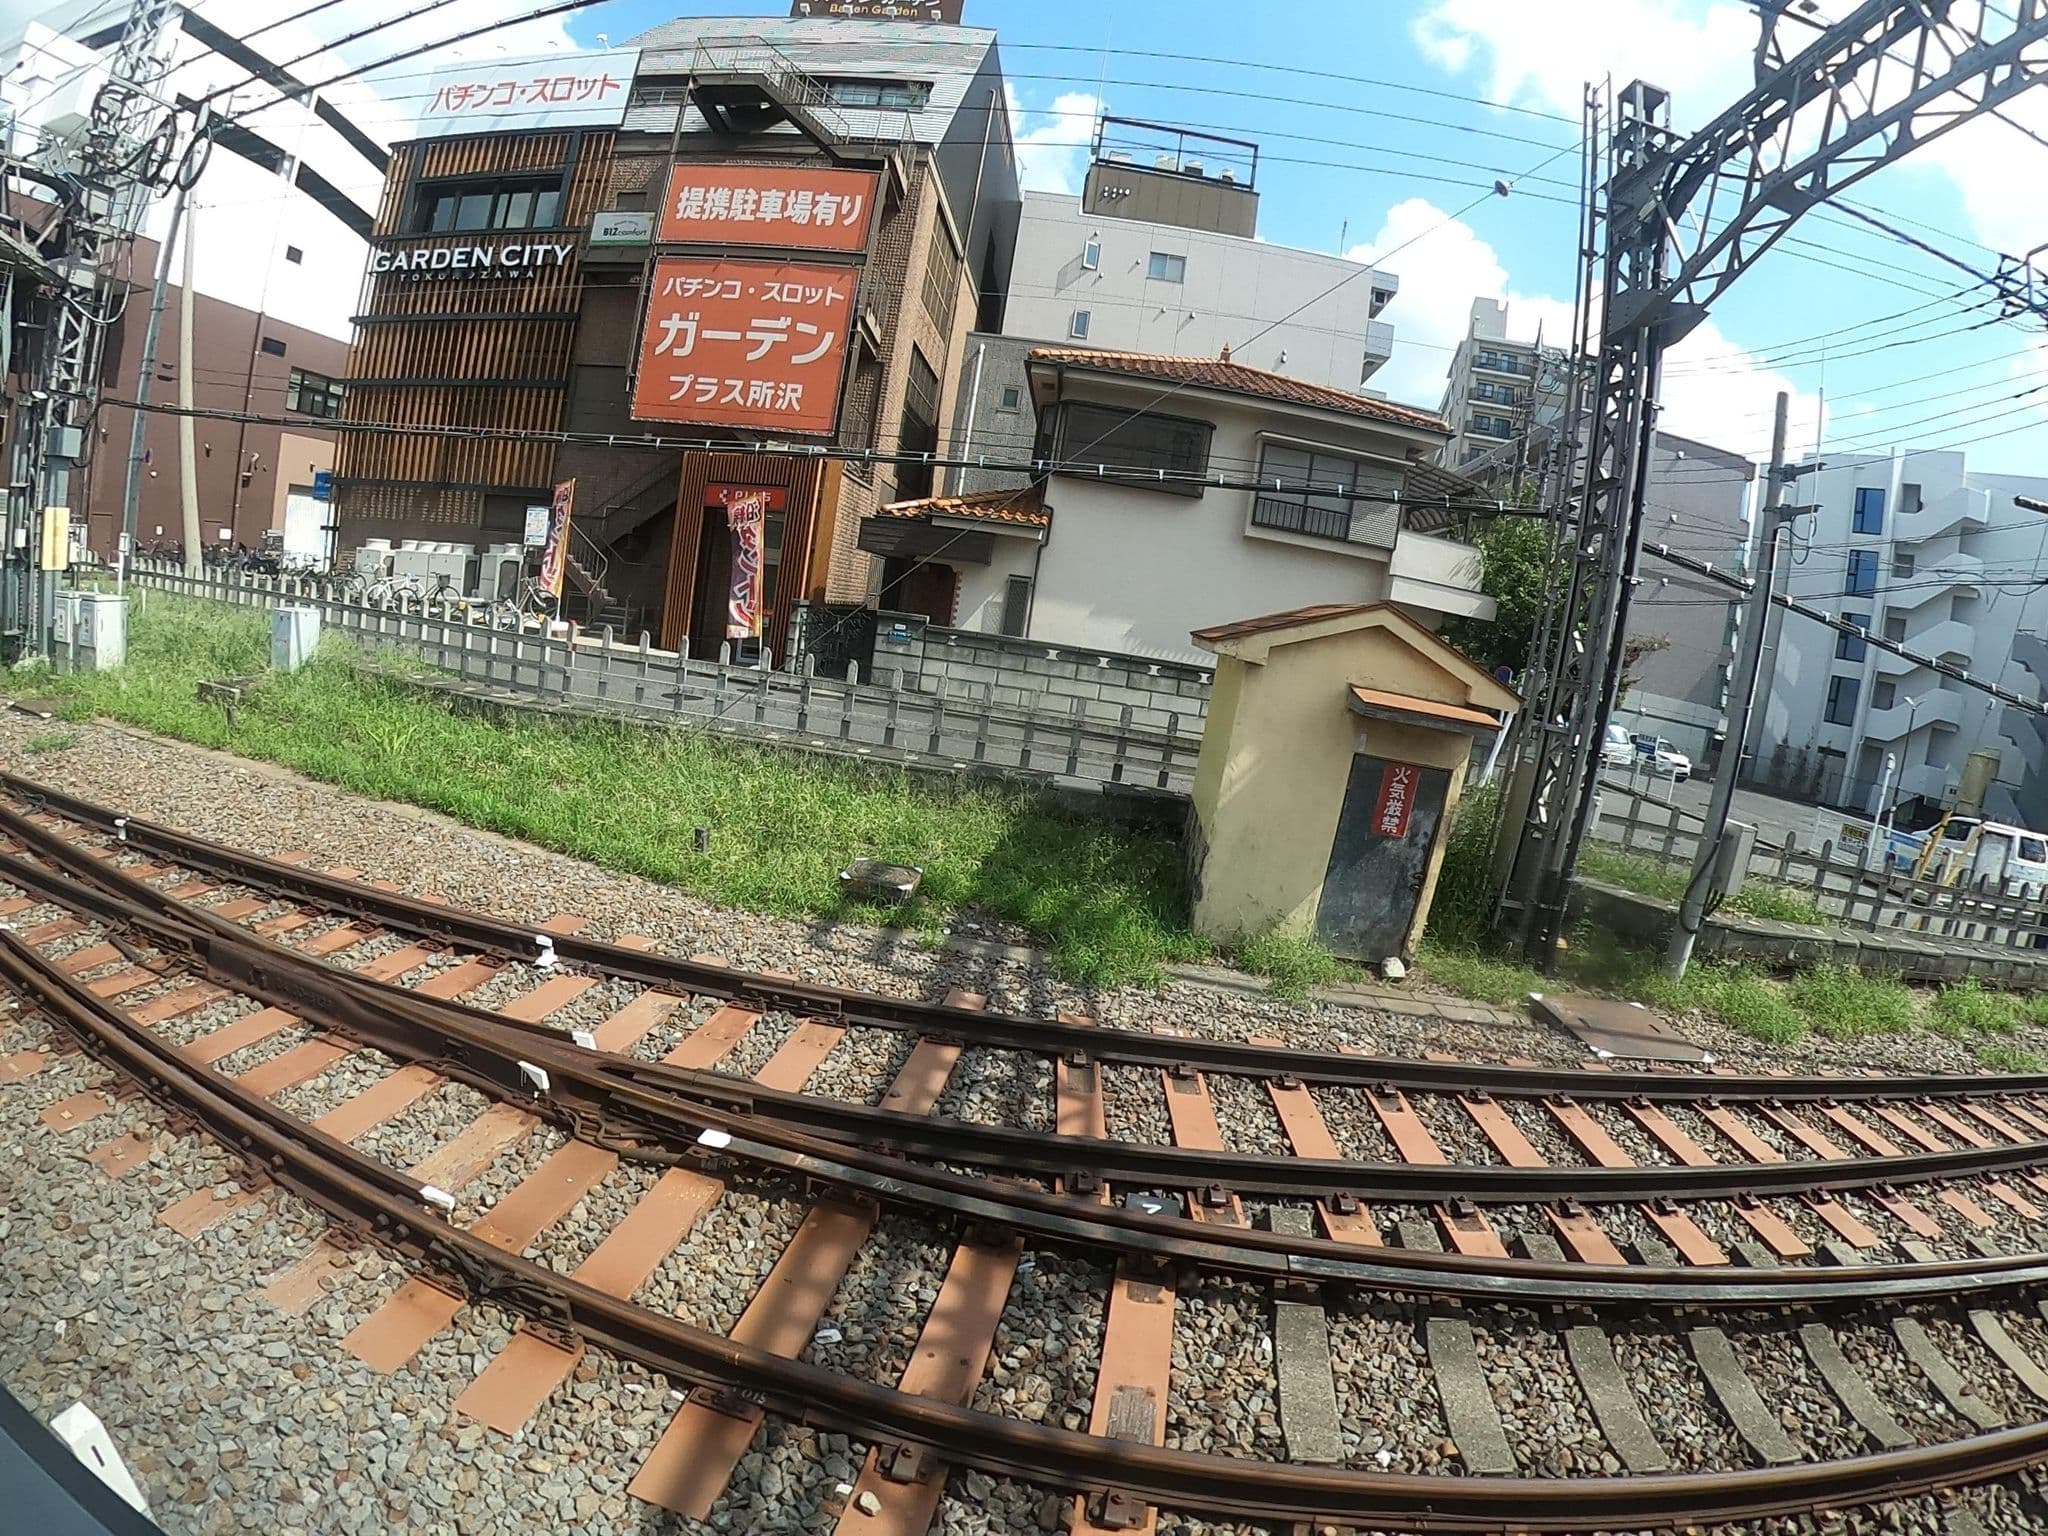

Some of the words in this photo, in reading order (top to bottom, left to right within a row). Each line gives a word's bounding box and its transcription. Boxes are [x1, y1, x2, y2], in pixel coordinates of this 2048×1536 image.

[871, 5, 918, 16] Gaden
[430, 73, 621, 113] パチンコ・スロット
[675, 185, 863, 227] 提携駐車場有り
[373, 246, 494, 272] GARDEN
[501, 244, 574, 267] CITY
[662, 276, 845, 307] パチンコ・スロット
[654, 311, 836, 365] ガーデン
[669, 373, 804, 412] プラス所沢
[1381, 767, 1412, 833] 火気厳禁
